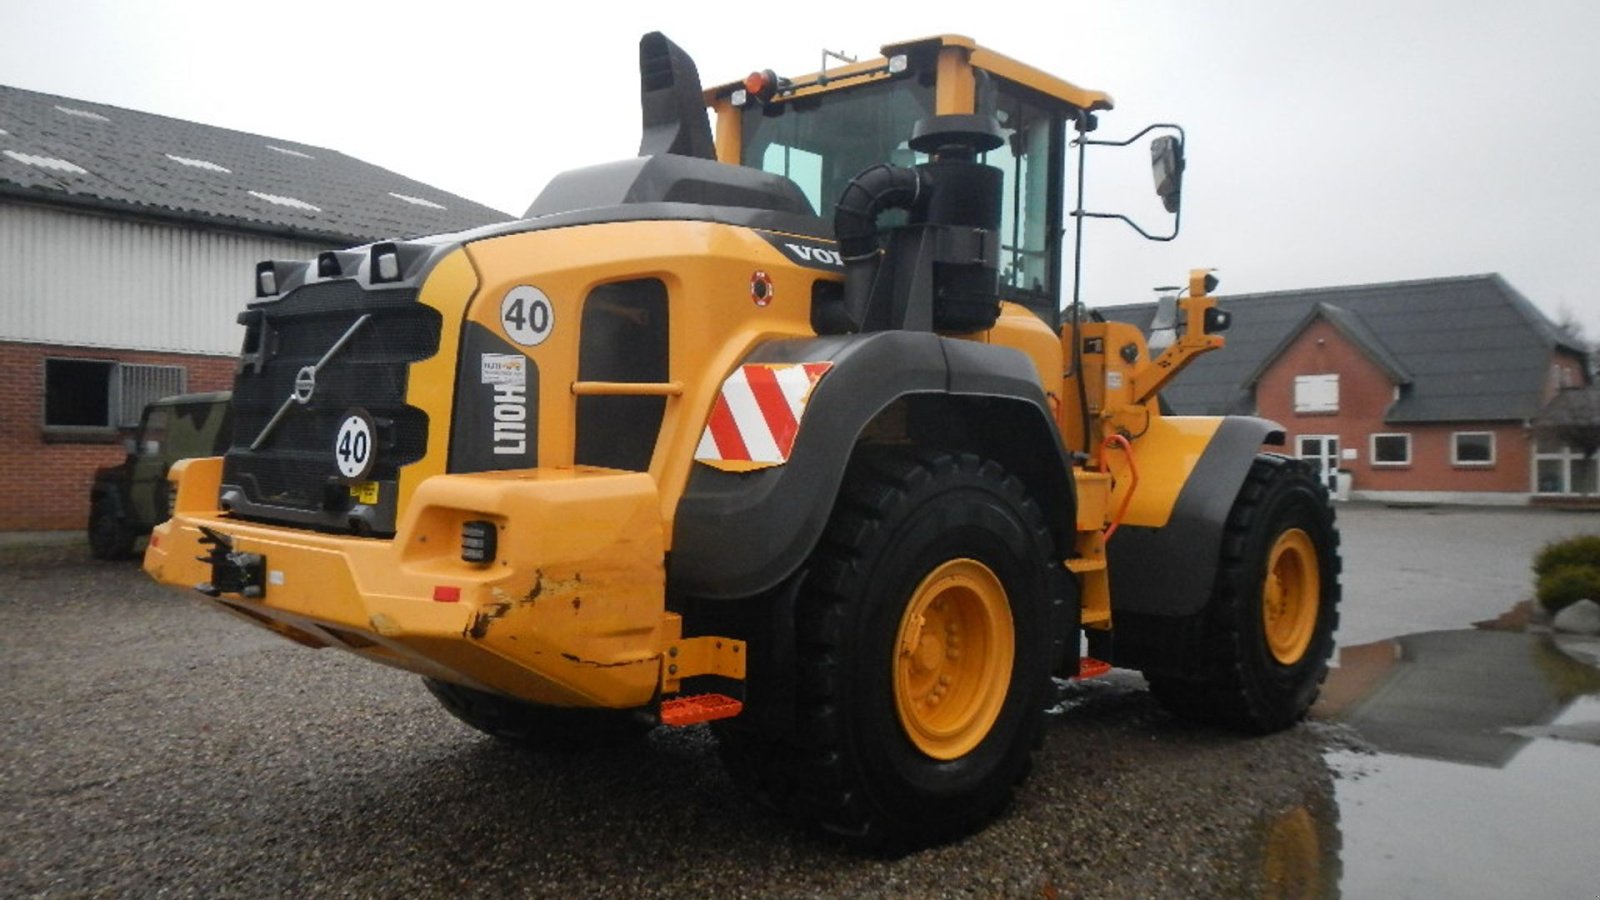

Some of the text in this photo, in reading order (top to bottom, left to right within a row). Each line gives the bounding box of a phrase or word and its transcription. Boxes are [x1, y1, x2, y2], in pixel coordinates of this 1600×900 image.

[504, 298, 549, 334] 40
[493, 384, 526, 454] L110H
[338, 429, 367, 464] 40
